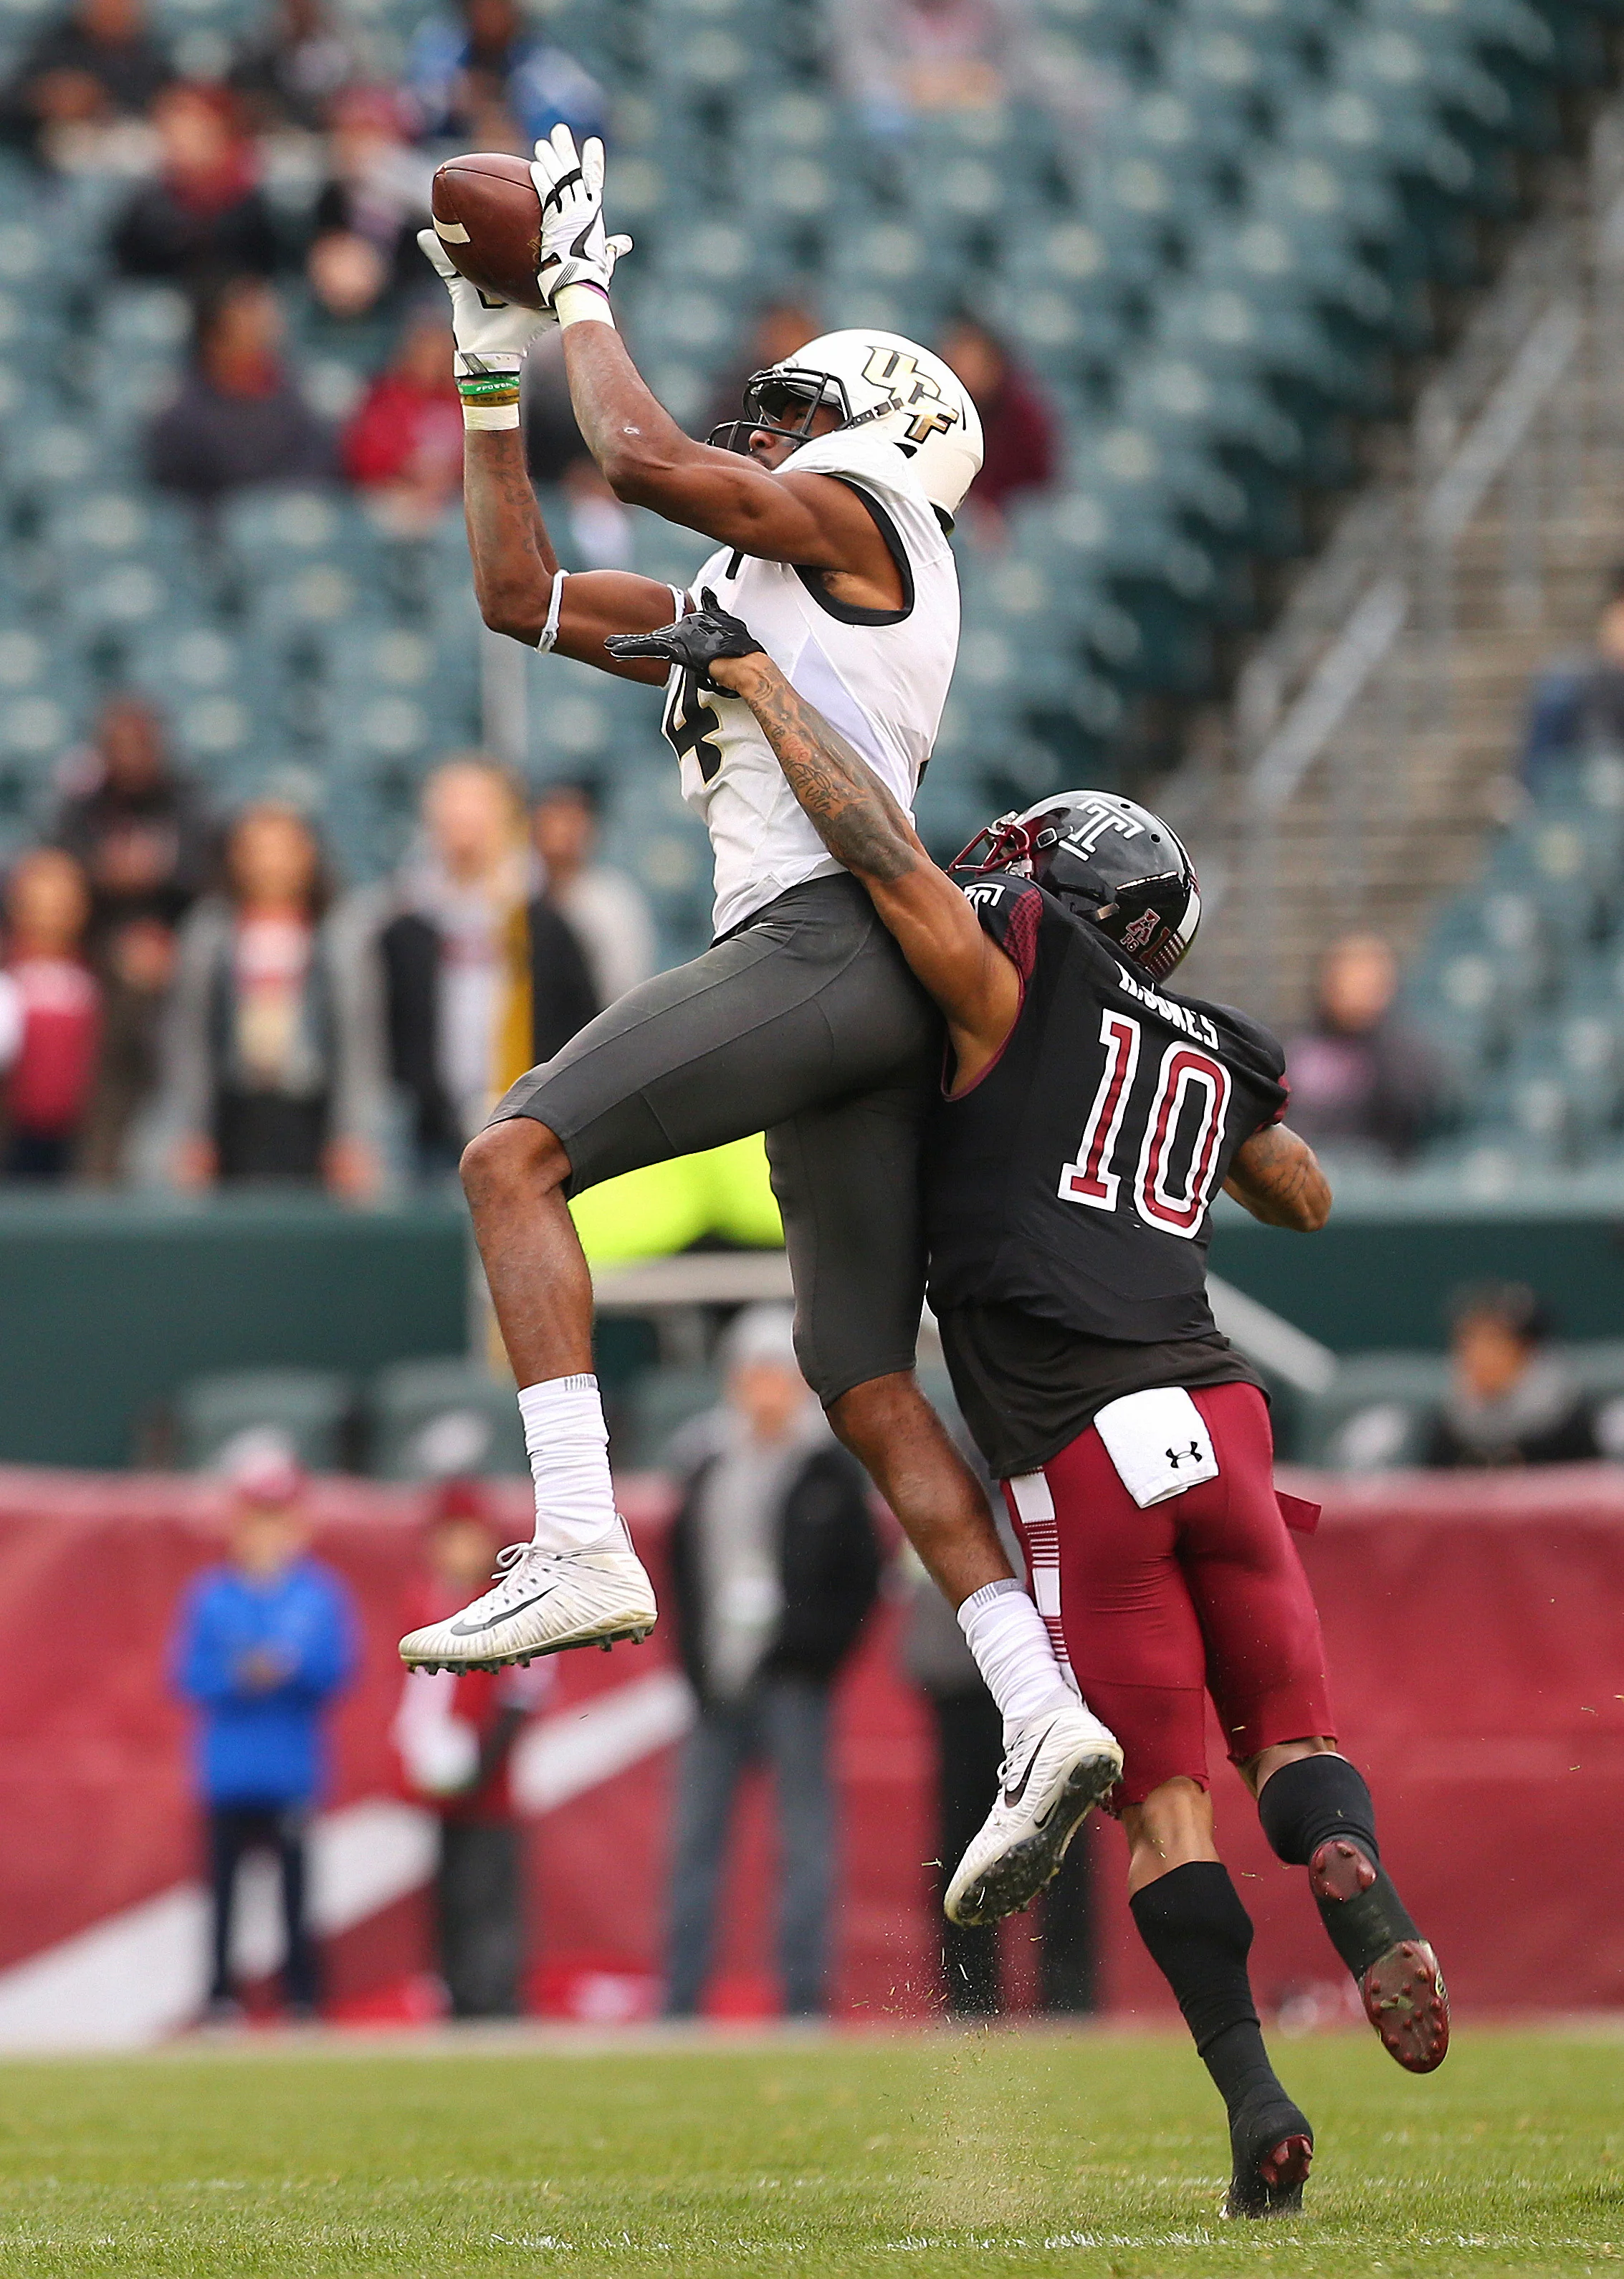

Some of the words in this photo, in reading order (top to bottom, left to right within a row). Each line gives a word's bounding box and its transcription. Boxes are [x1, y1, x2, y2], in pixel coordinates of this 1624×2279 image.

[862, 345, 960, 445] UCF
[1059, 797, 1145, 861] T
[1057, 1008, 1232, 1240] 10
